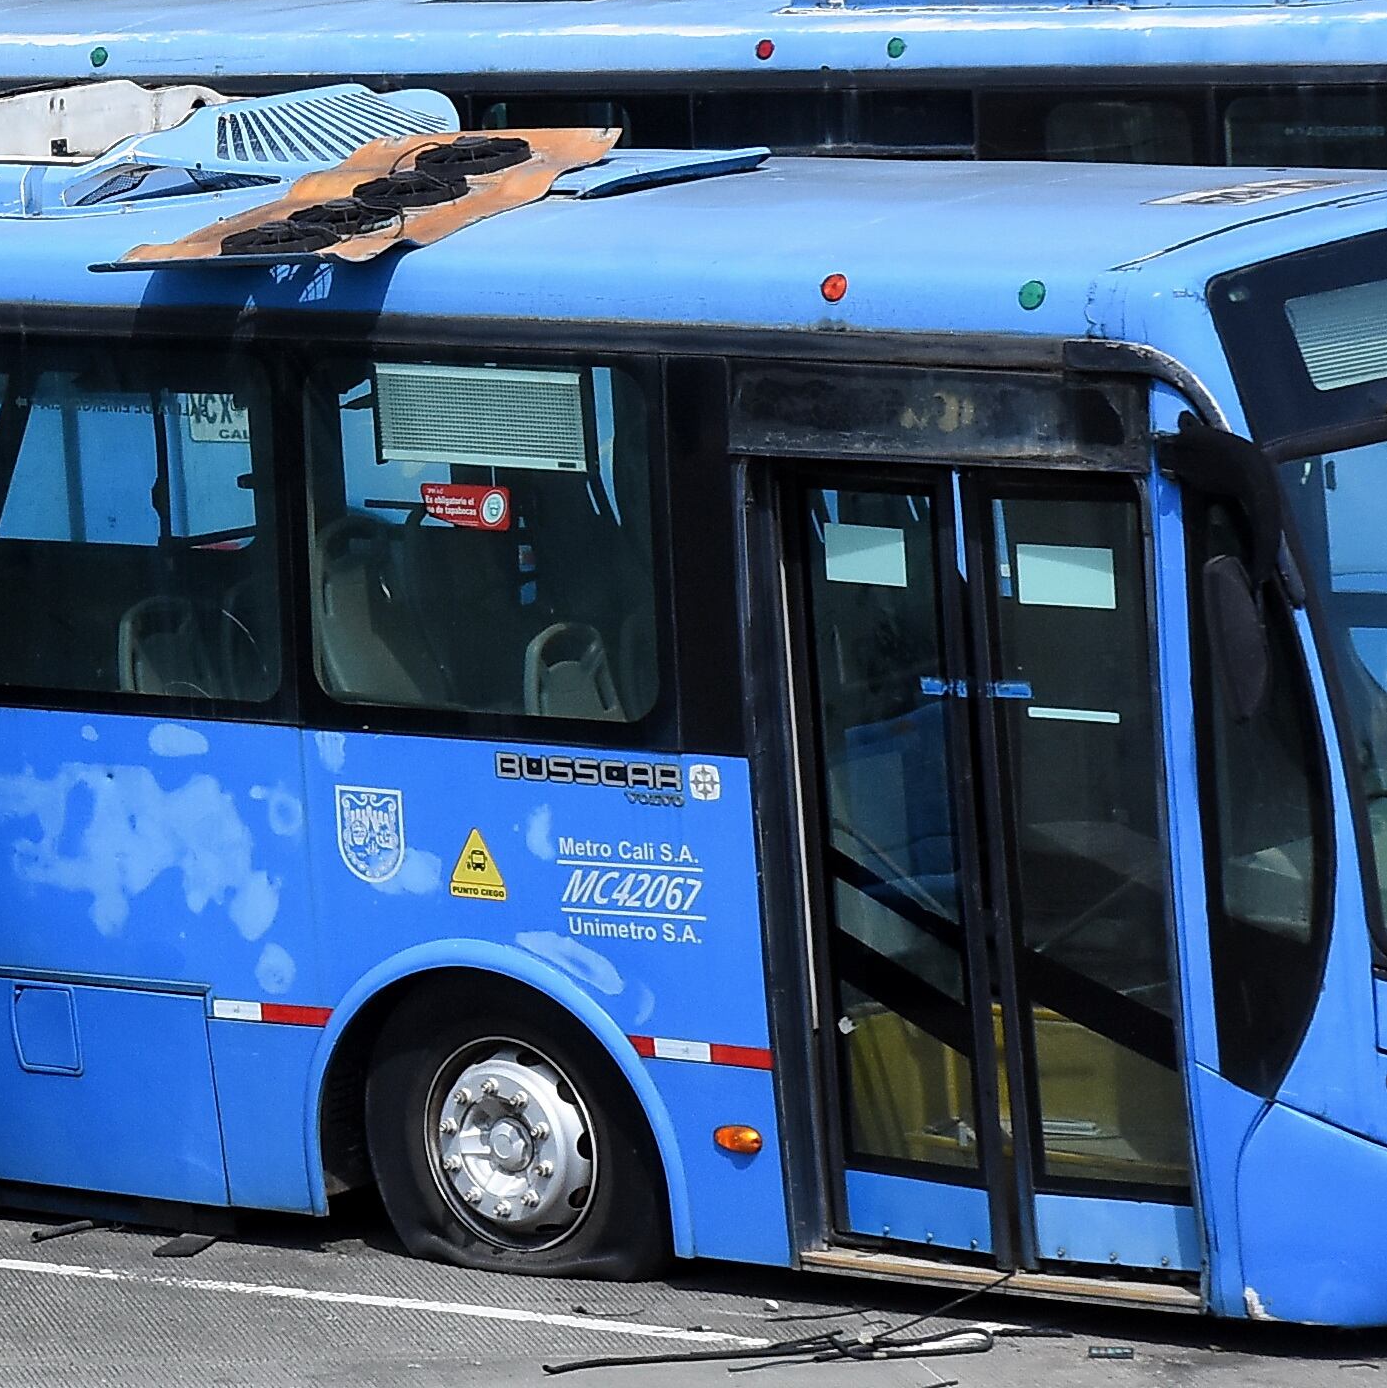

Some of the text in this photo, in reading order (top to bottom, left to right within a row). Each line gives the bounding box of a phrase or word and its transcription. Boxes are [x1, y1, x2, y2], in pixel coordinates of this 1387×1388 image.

[495, 750, 683, 791] BUSSCAR
[558, 836, 699, 864] Metro Cali S.A.
[452, 886, 505, 898] PUNTO CIEGO
[561, 868, 702, 911] MC42067
[568, 917, 702, 944] Unimetro S.A.
